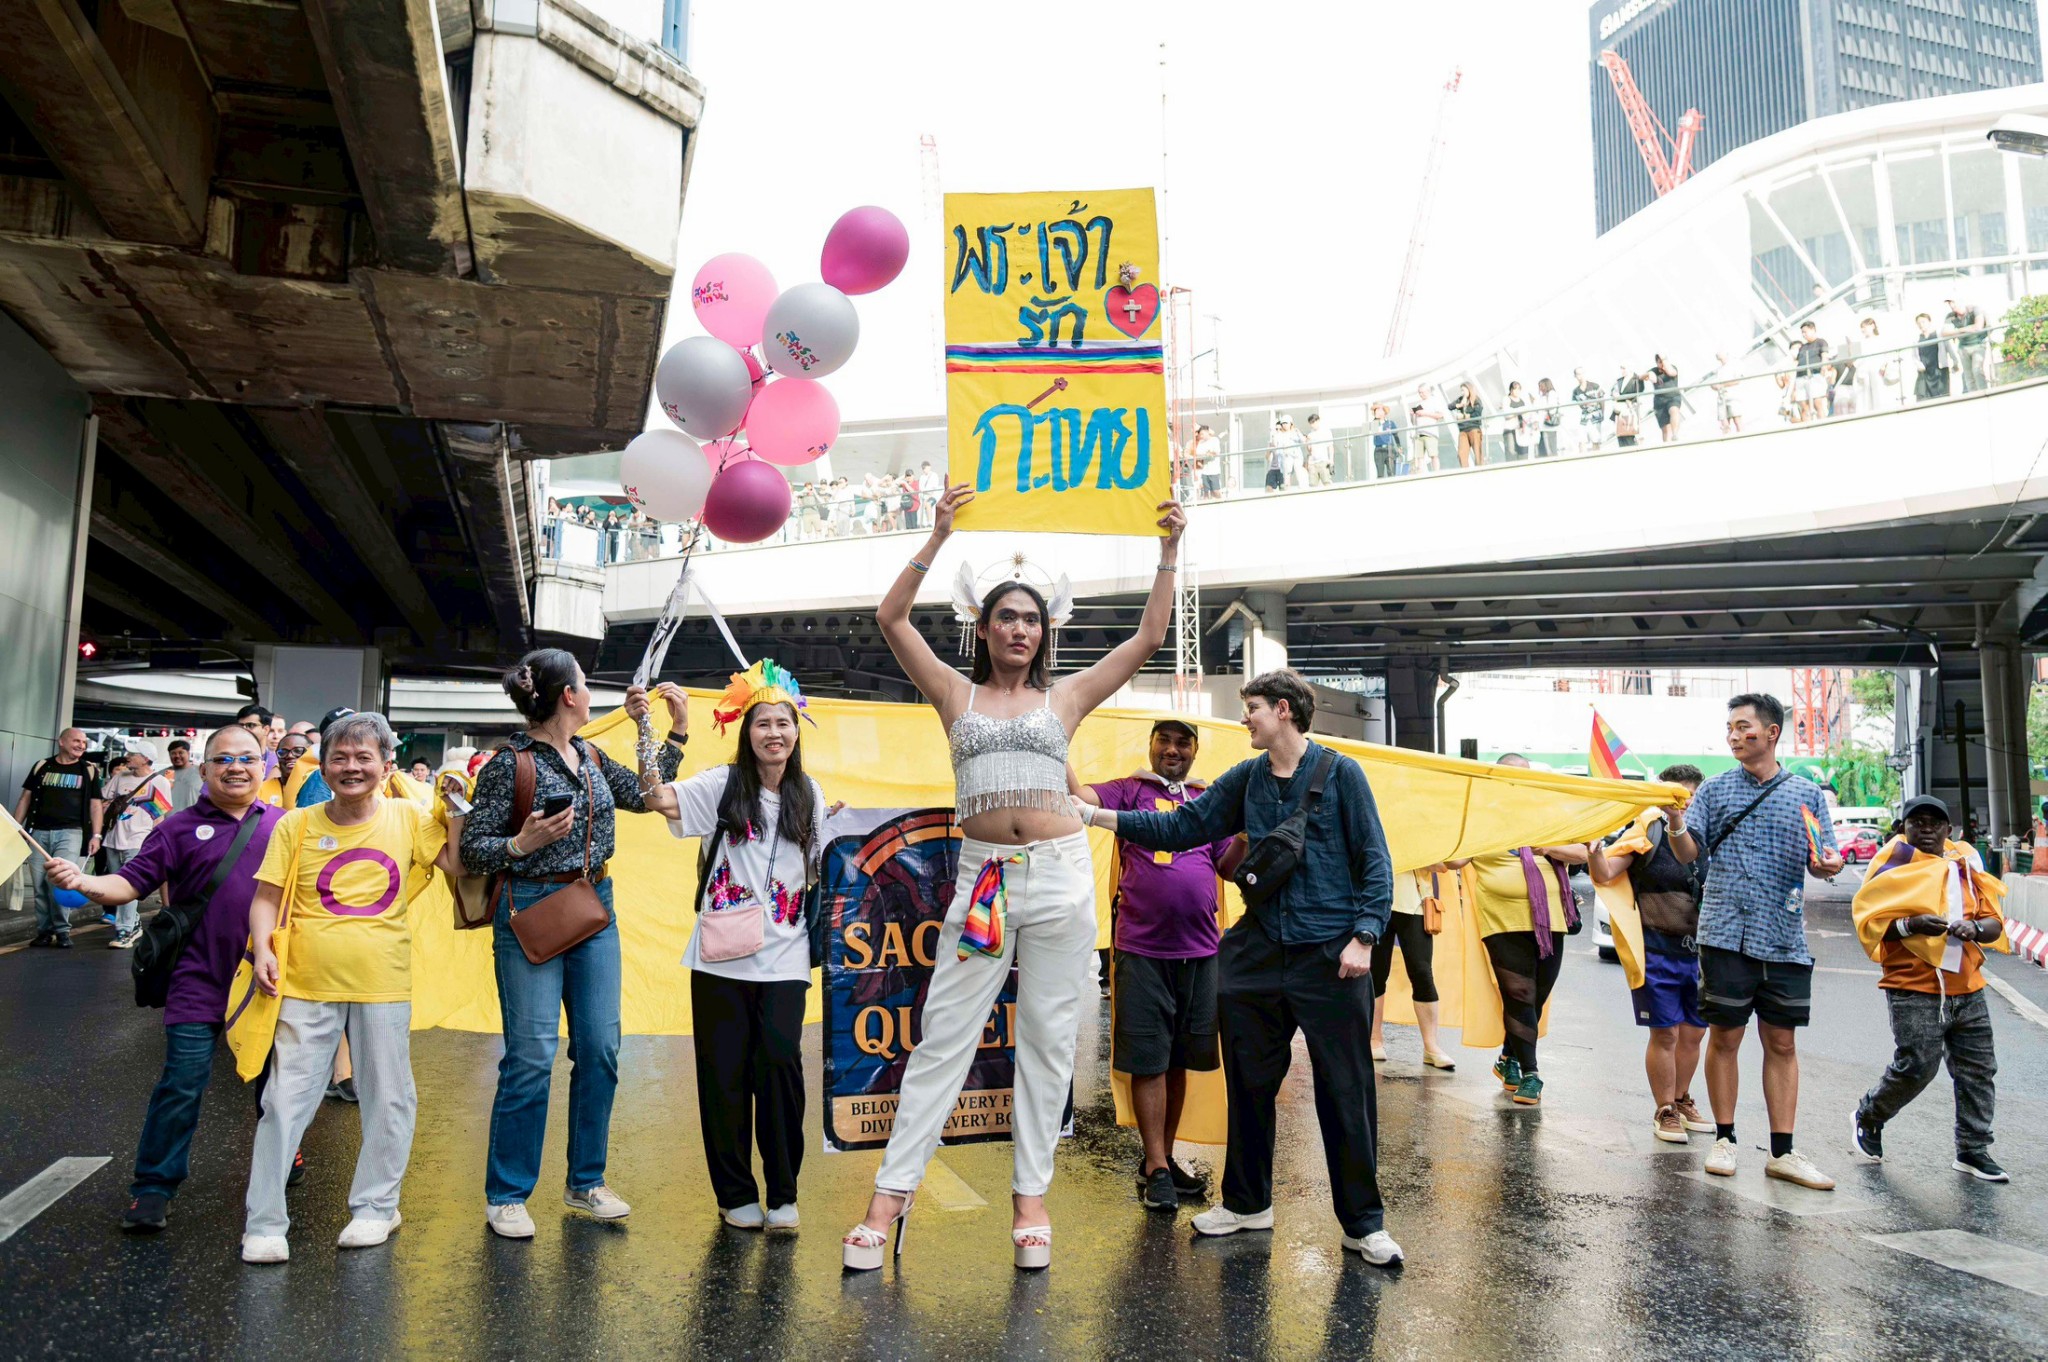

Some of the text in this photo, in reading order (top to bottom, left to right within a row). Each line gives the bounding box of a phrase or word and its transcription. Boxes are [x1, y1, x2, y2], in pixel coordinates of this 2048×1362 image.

[951, 200, 1113, 294] พระเจ้า
[1018, 296, 1088, 349] รัก
[972, 403, 1150, 492] กะเทย
[844, 920, 943, 968] SAC
[854, 1002, 1018, 1060] QUE
[851, 1100, 899, 1115] BELOV
[953, 1095, 998, 1110] VERY
[860, 1118, 895, 1133] DIVI
